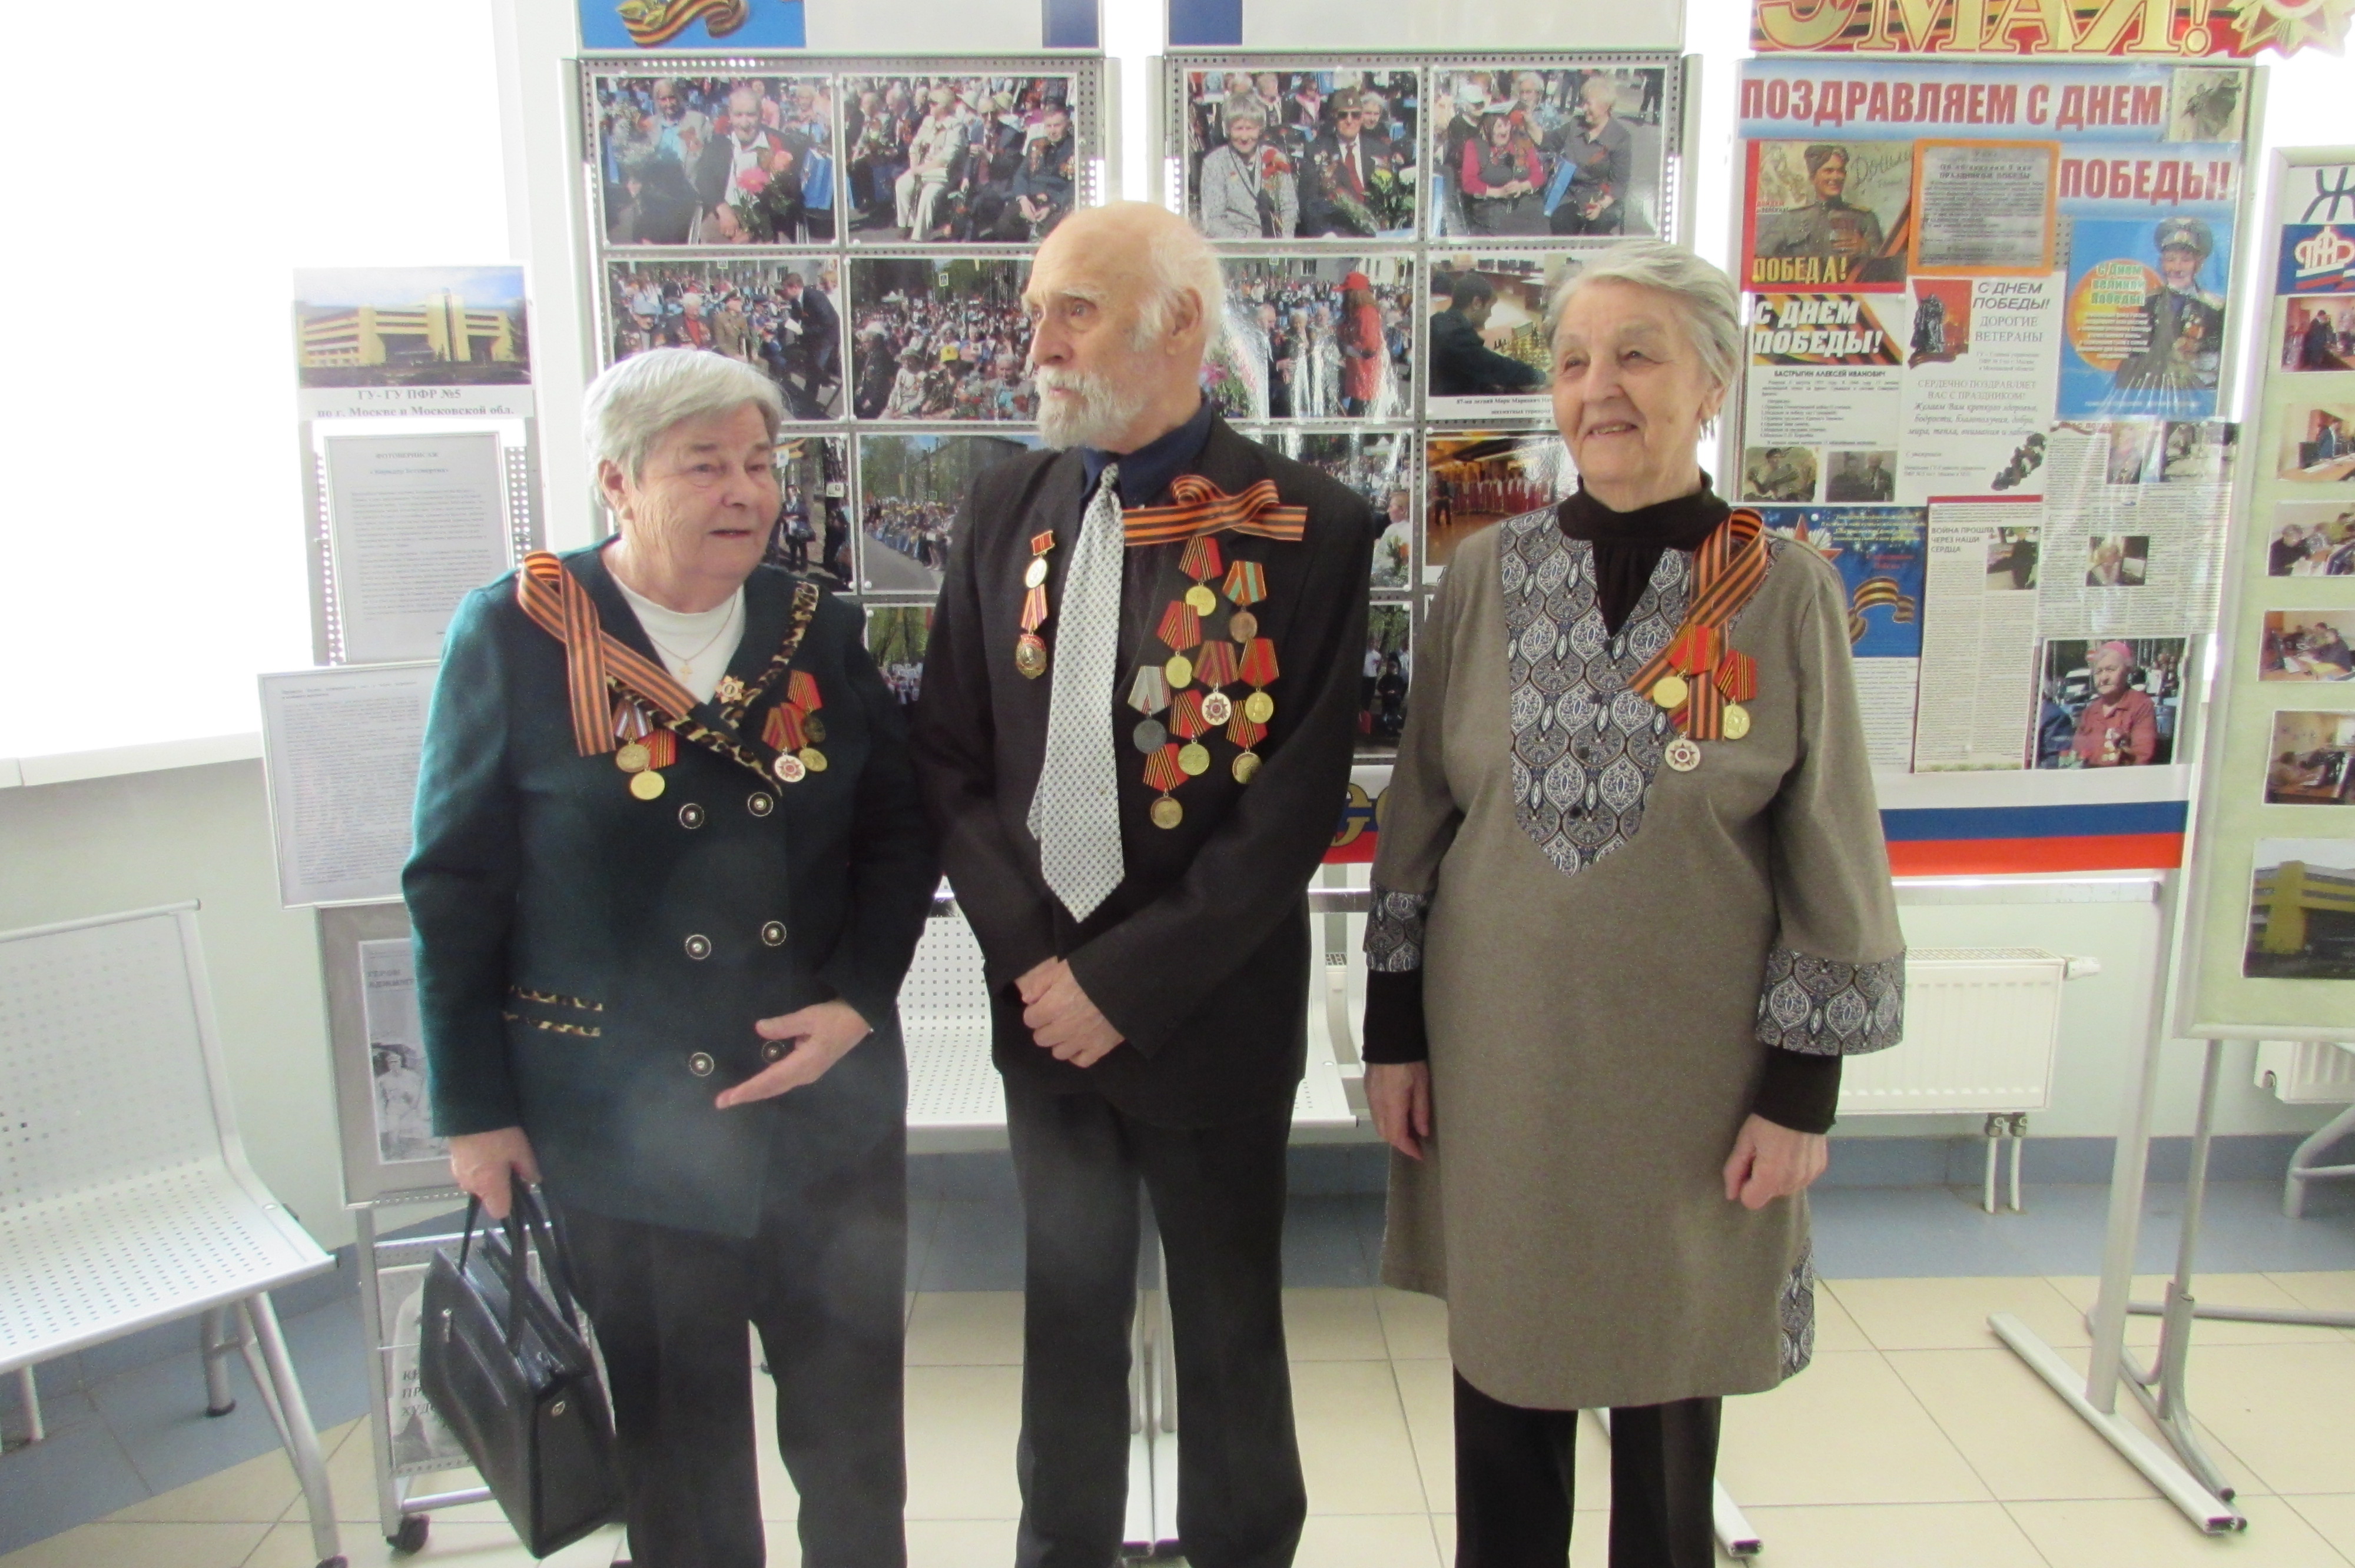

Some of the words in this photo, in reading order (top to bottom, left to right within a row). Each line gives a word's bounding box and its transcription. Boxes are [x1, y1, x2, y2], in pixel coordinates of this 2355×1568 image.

[1740, 79, 2018, 128] ПОЗДРАВЛЯЕМ
[2026, 85, 2049, 125] С
[2055, 85, 2163, 131] ДНЕМ
[2060, 158, 2231, 206] ПОБЕДЫ!
[1978, 282, 1989, 294] С
[1991, 282, 2043, 295] ДНЕМ
[1972, 297, 2051, 311] ПОБЕДЫ!
[1754, 301, 1773, 325] С
[1777, 300, 1861, 329] ДНЕМ
[1979, 315, 2039, 328] ДОРОГИЕ
[1974, 331, 2044, 343] ВЕТЕРАНЫ
[1753, 330, 1883, 358] ПОБЕДЫ!
[1815, 368, 1847, 377] АЛЕКСЕЙ
[1848, 369, 1886, 377] ИВАНОВИЧ
[1918, 380, 1967, 388] СЕРДЕЧНО
[1969, 380, 2036, 389] ПОЗДРАВЛЯЕТ
[407, 389, 438, 400] ПФР
[1928, 391, 1947, 400] ВАС
[1949, 391, 1955, 400] С
[349, 407, 397, 418] Москве
[410, 404, 487, 416] Московской
[490, 405, 515, 415] обл.
[1931, 527, 1959, 535] ВОЙНА
